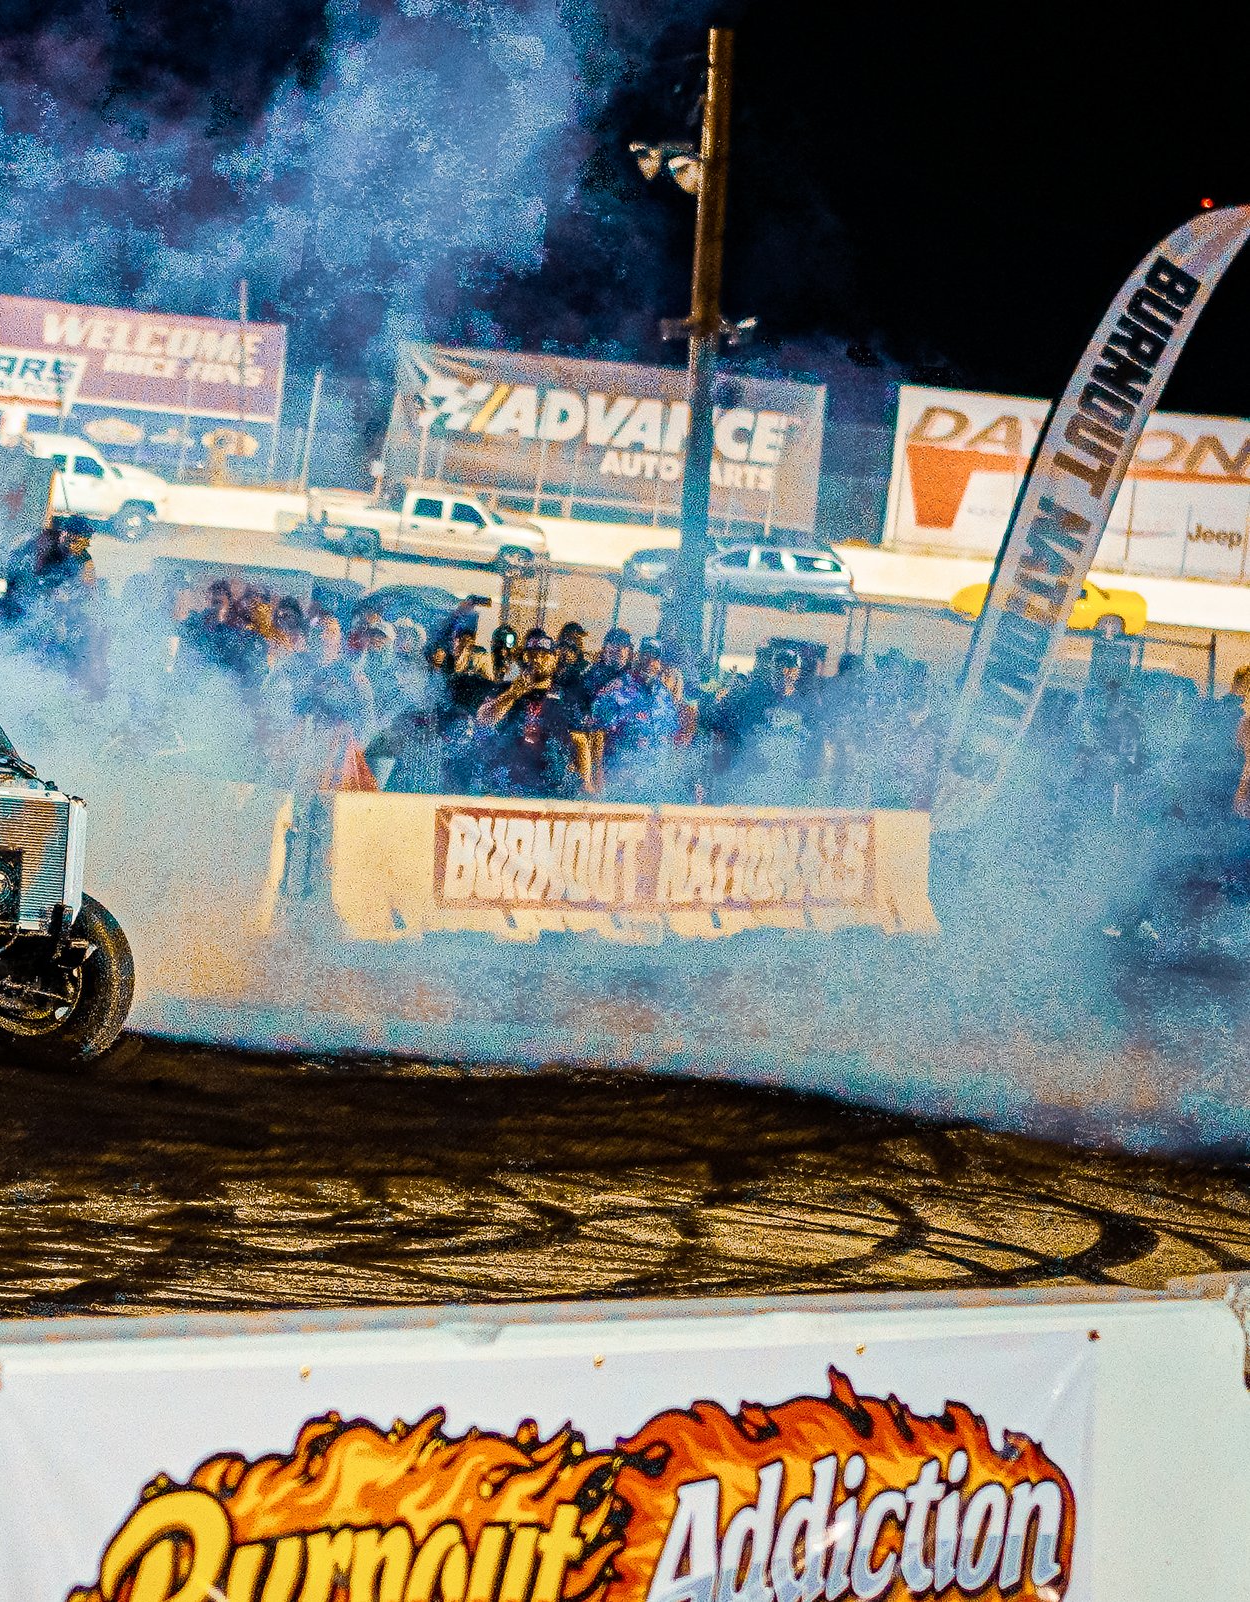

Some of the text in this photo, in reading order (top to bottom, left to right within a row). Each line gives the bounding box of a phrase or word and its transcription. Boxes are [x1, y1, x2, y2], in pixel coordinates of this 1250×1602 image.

[43, 312, 263, 365] WELCOME
[24, 381, 65, 397] TOU
[599, 450, 776, 491] AUTO ARTS
[909, 405, 1250, 476] DAON
[948, 256, 1201, 782] BURNOUT NATIONA
[1187, 522, 1243, 550] Jeep
[445, 813, 869, 904] BURNOUT NATIONALS
[101, 1450, 1062, 1602] Burnout Addiction
